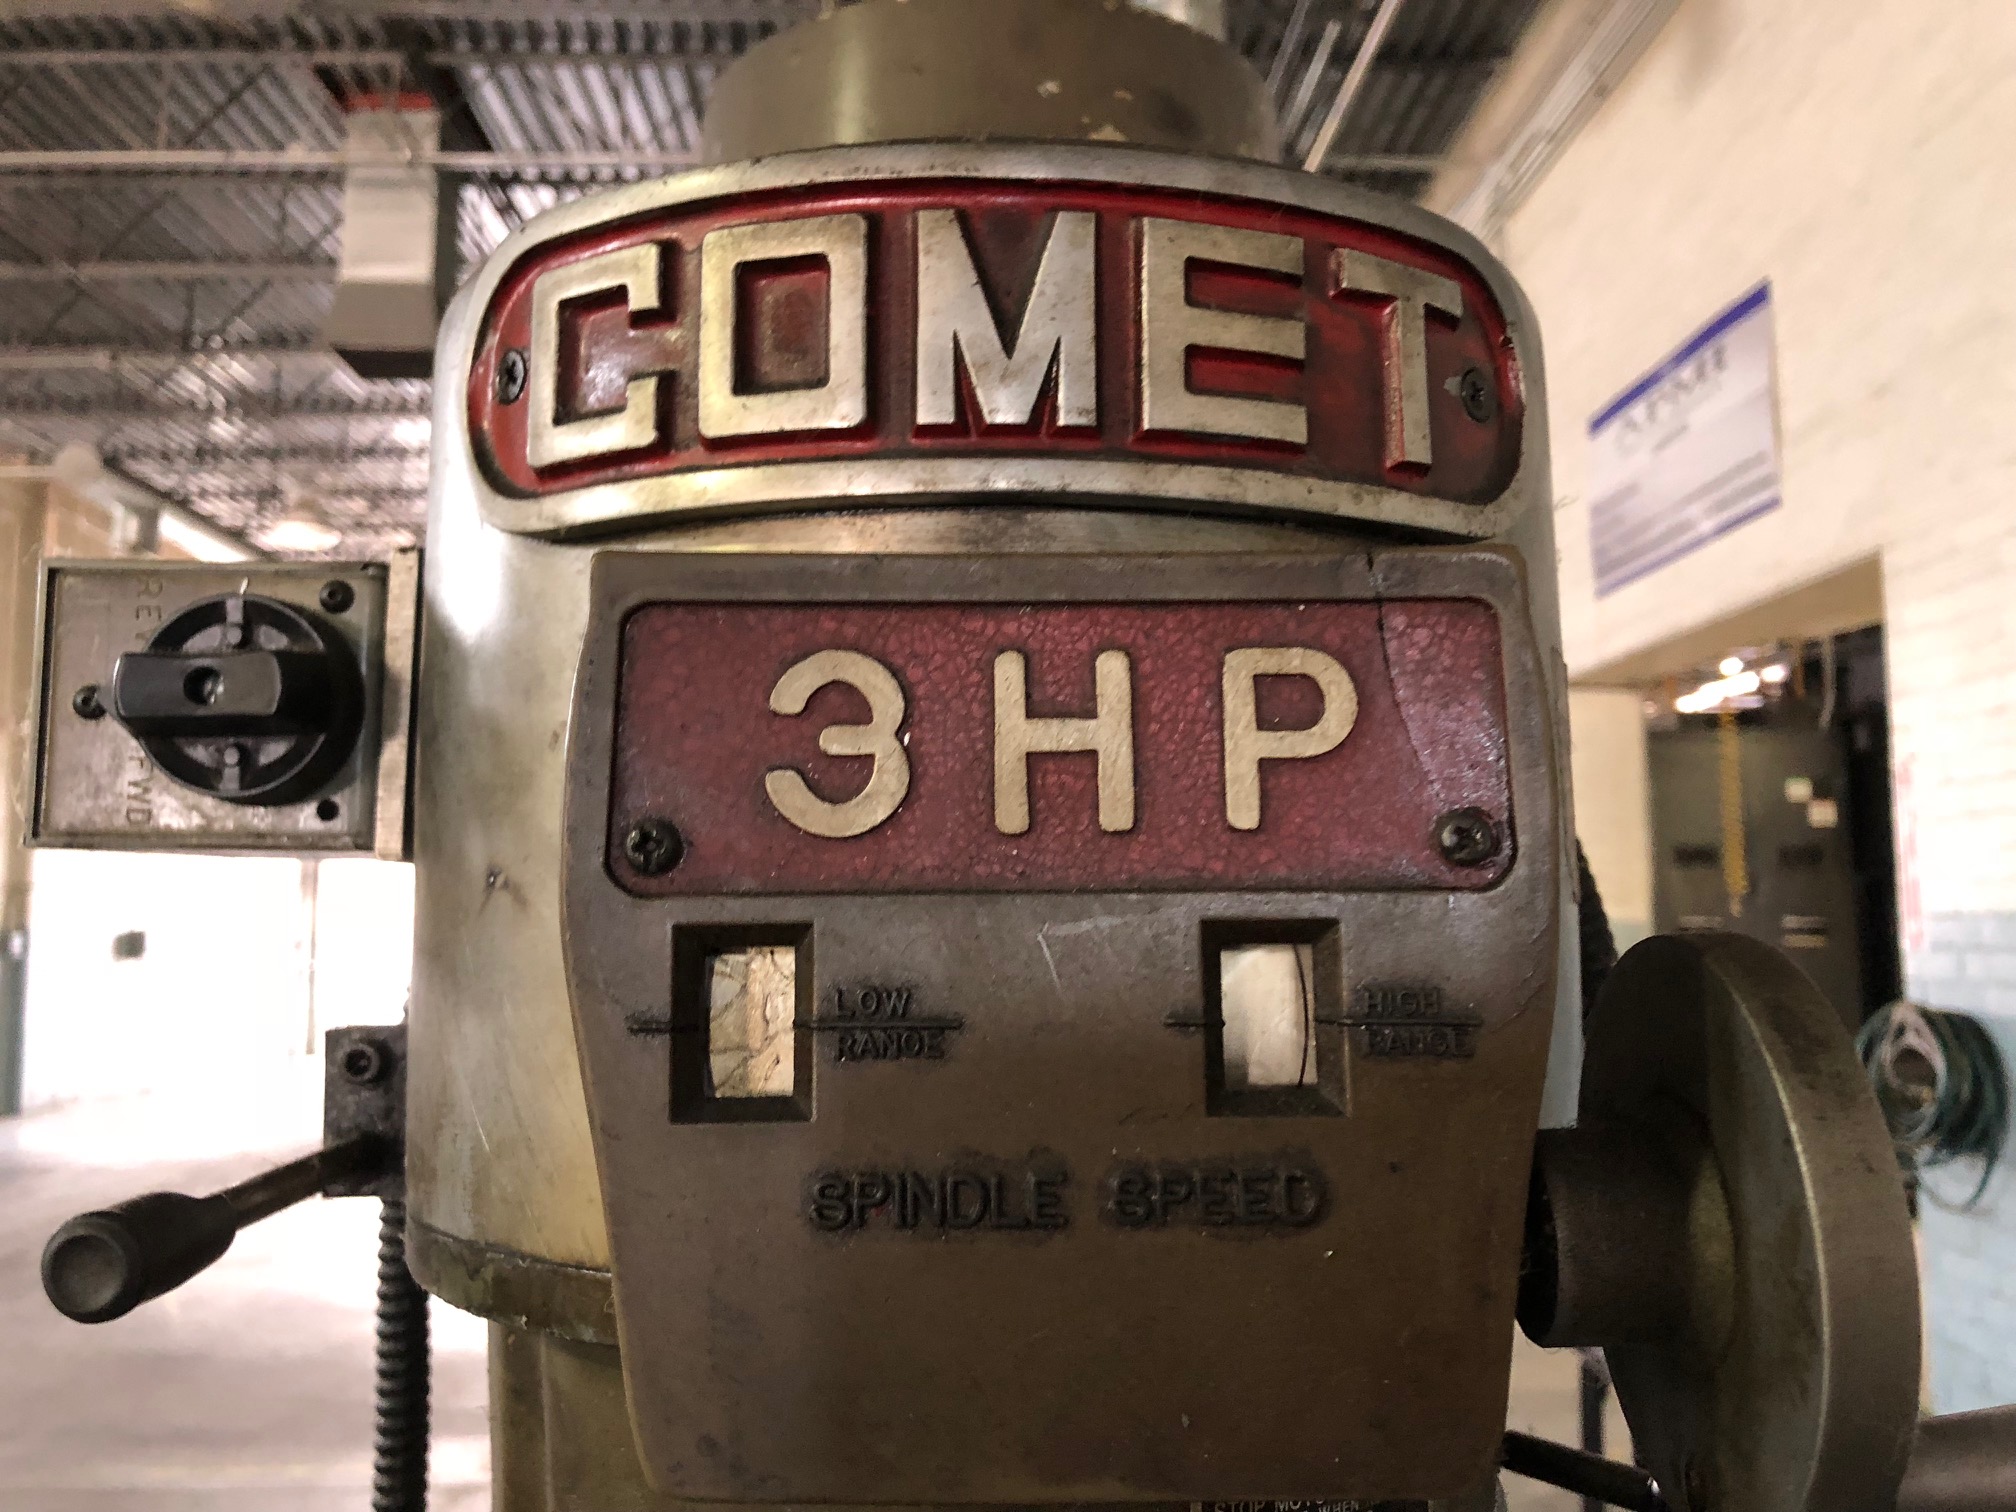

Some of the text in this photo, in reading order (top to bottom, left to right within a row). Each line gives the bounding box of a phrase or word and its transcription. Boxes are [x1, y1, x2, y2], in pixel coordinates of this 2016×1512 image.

[526, 208, 1465, 474] COMET
[835, 986, 913, 1018] LOW
[1362, 986, 1441, 1016] HIGH
[807, 1164, 1326, 1230] SPINDLE SPEED
